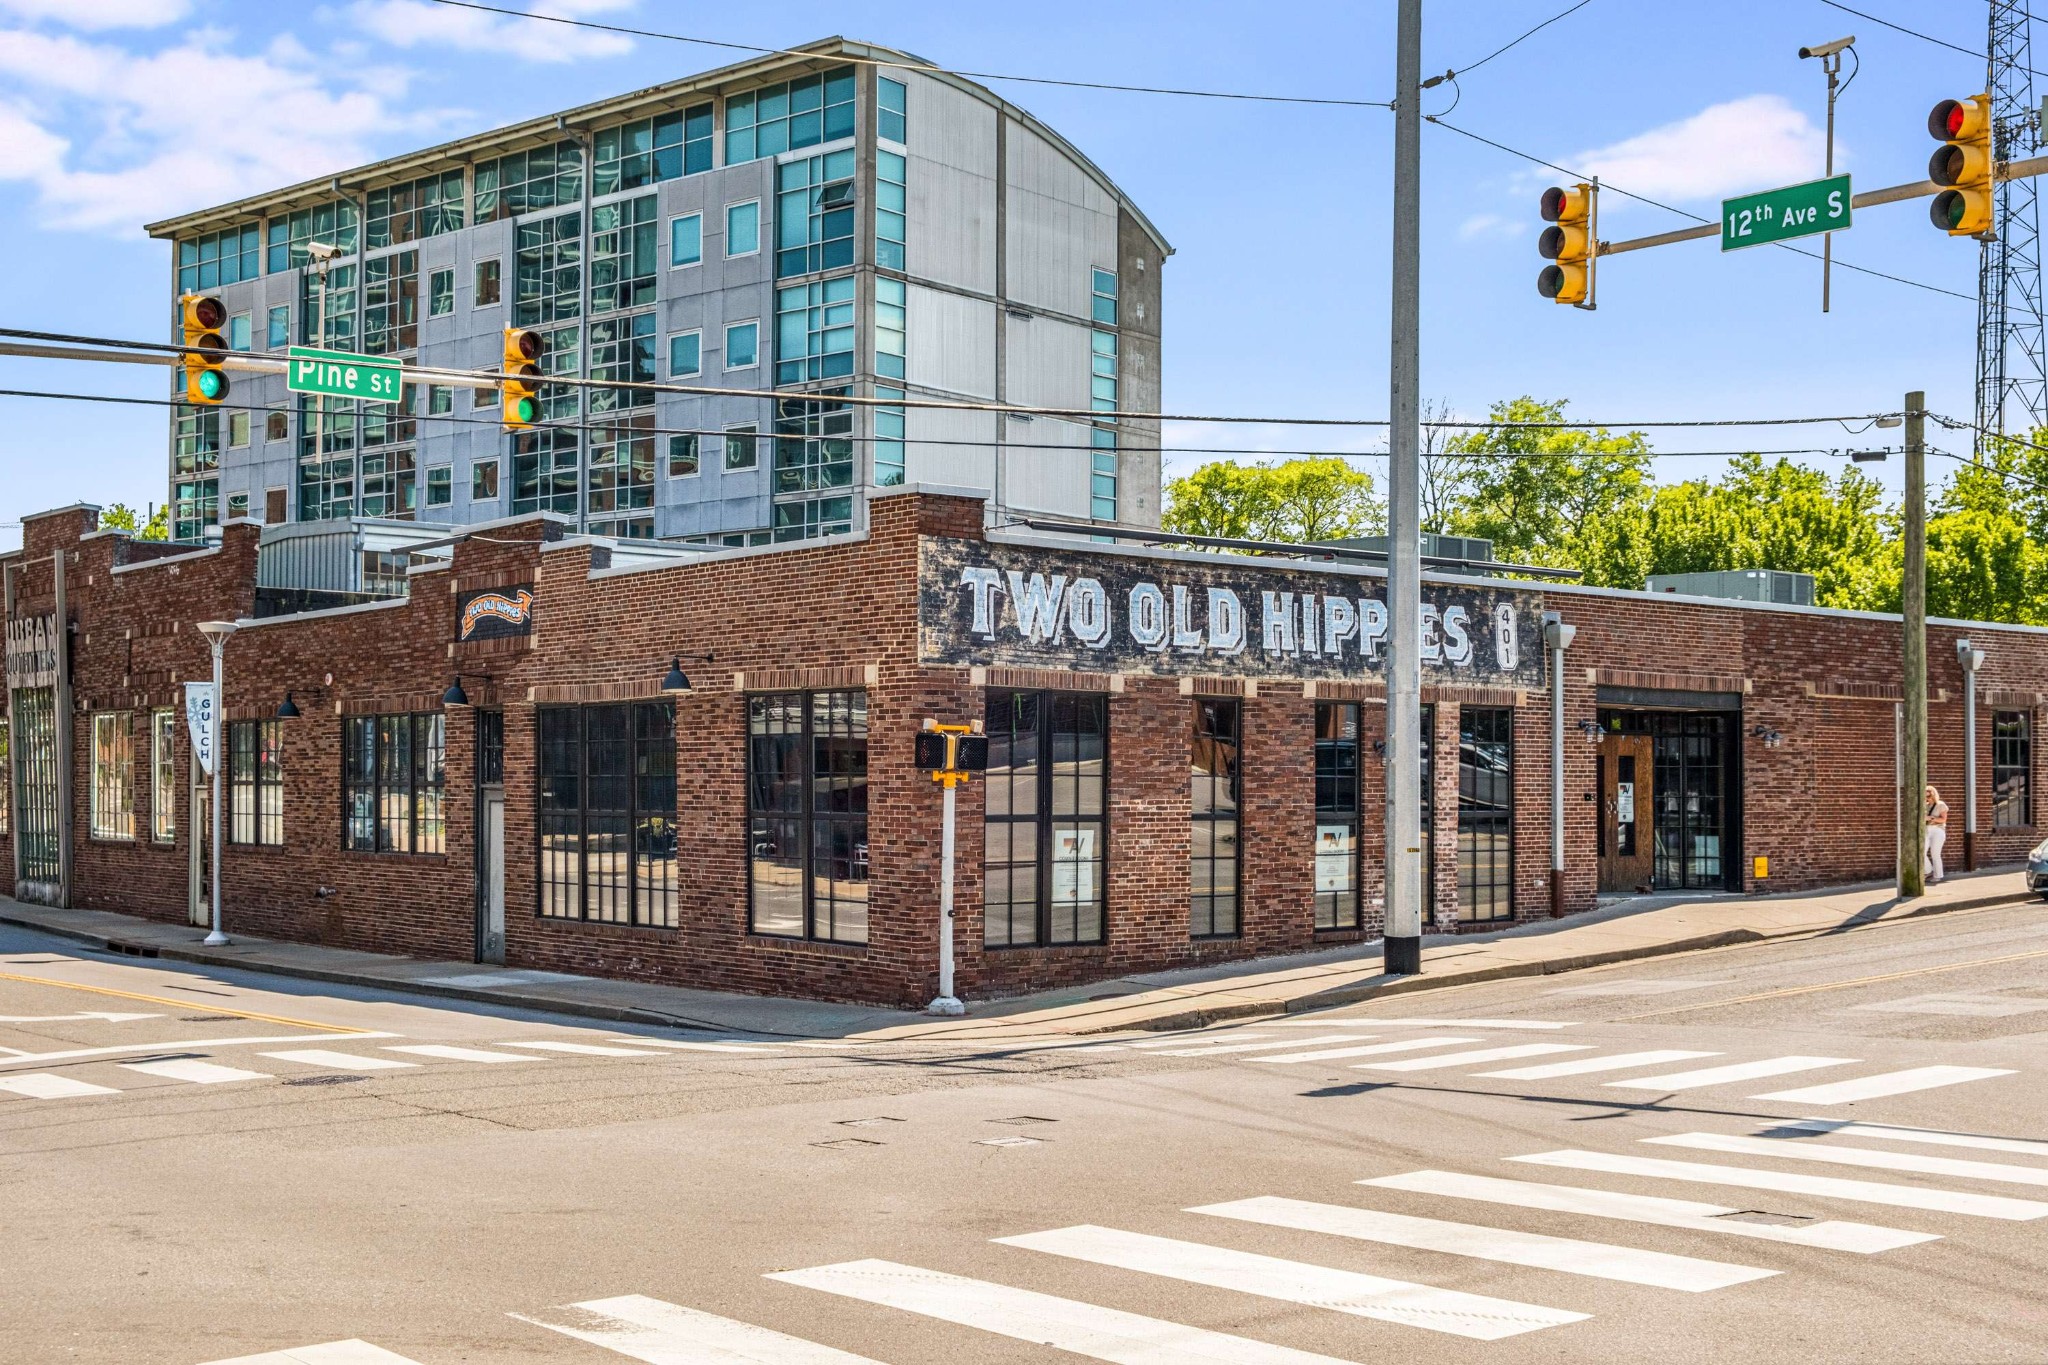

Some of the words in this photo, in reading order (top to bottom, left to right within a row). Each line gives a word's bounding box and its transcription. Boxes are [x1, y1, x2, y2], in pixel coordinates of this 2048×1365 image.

[1729, 204, 1773, 238] 12th
[1782, 207, 1817, 228] Ave
[1827, 190, 1843, 218] S
[298, 360, 358, 390] Pine
[960, 566, 1111, 647] TWO
[1129, 582, 1247, 655] OLD
[1262, 590, 1473, 666] HIPPES
[1501, 609, 1511, 664] 401
[200, 699, 211, 759] GULCH
